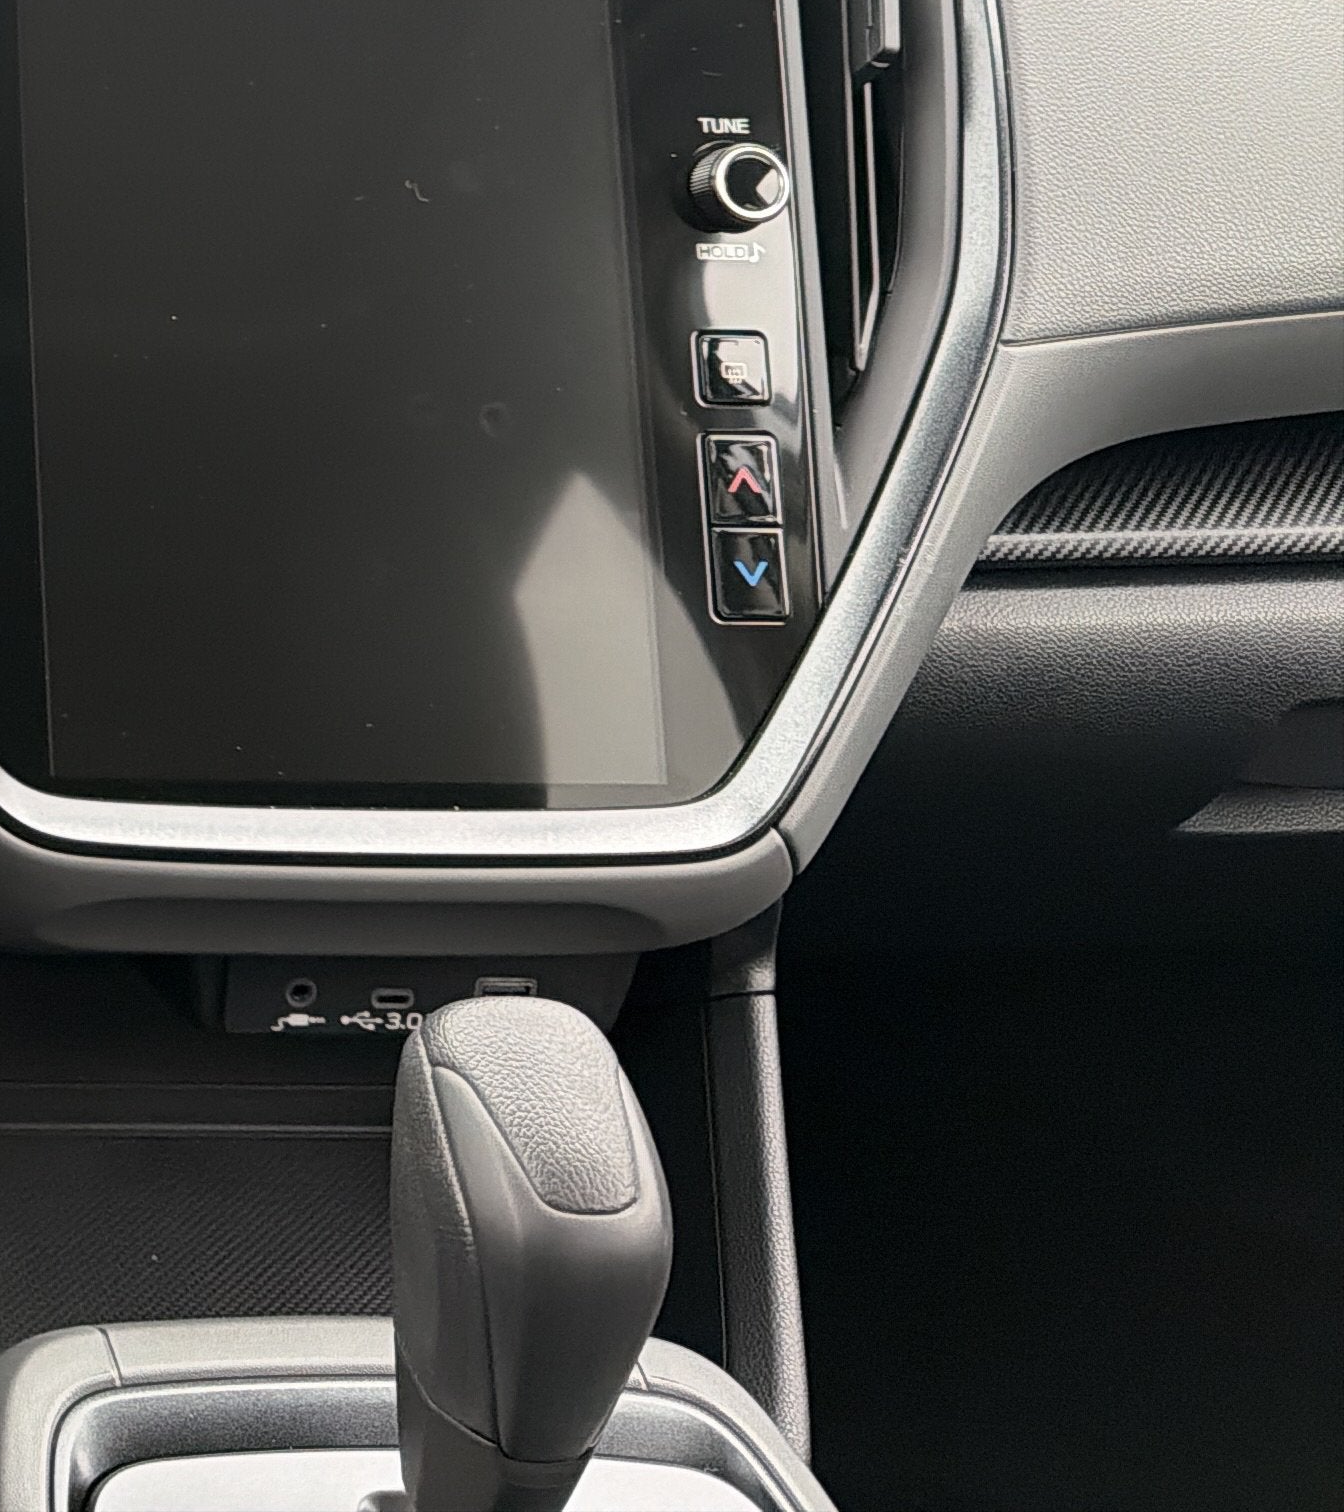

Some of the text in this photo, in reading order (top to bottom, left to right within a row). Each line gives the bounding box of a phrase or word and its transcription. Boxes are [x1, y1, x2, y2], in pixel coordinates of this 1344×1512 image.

[696, 117, 751, 134] TUNE
[698, 244, 746, 260] HOLD
[385, 1013, 424, 1031] 3.0
